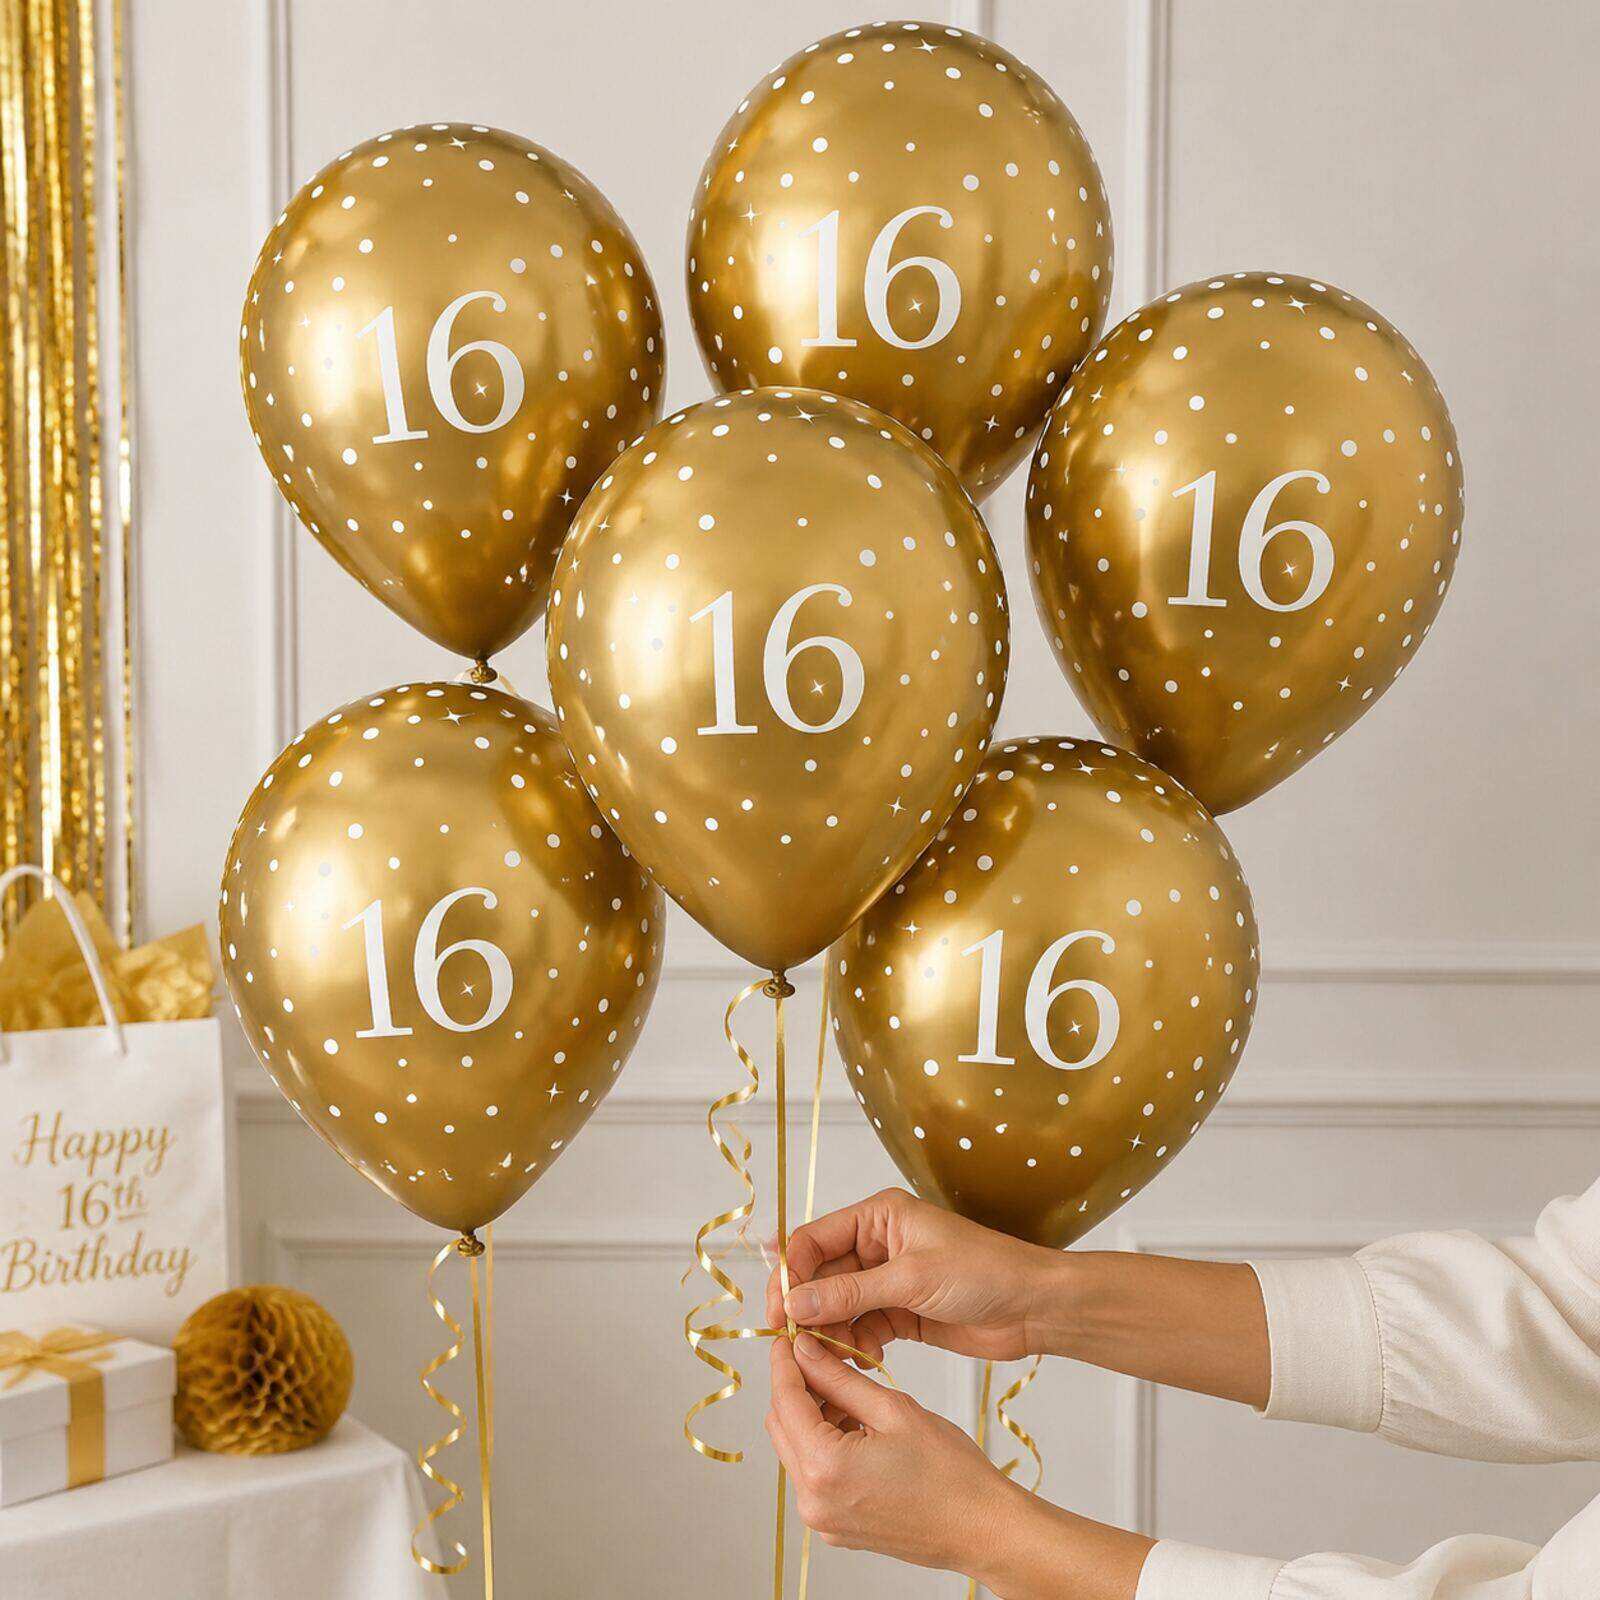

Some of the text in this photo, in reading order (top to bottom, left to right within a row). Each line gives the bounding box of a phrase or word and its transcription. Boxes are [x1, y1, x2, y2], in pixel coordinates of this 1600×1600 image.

[797, 205, 961, 350] 16
[354, 291, 525, 444] 16
[1166, 470, 1335, 612] 16
[689, 583, 865, 736] 16
[342, 887, 514, 1040] 16
[957, 929, 1120, 1070] 16
[13, 1109, 176, 1177] Happy
[56, 1175, 148, 1230] 16th
[0, 1230, 199, 1297] Birthday
